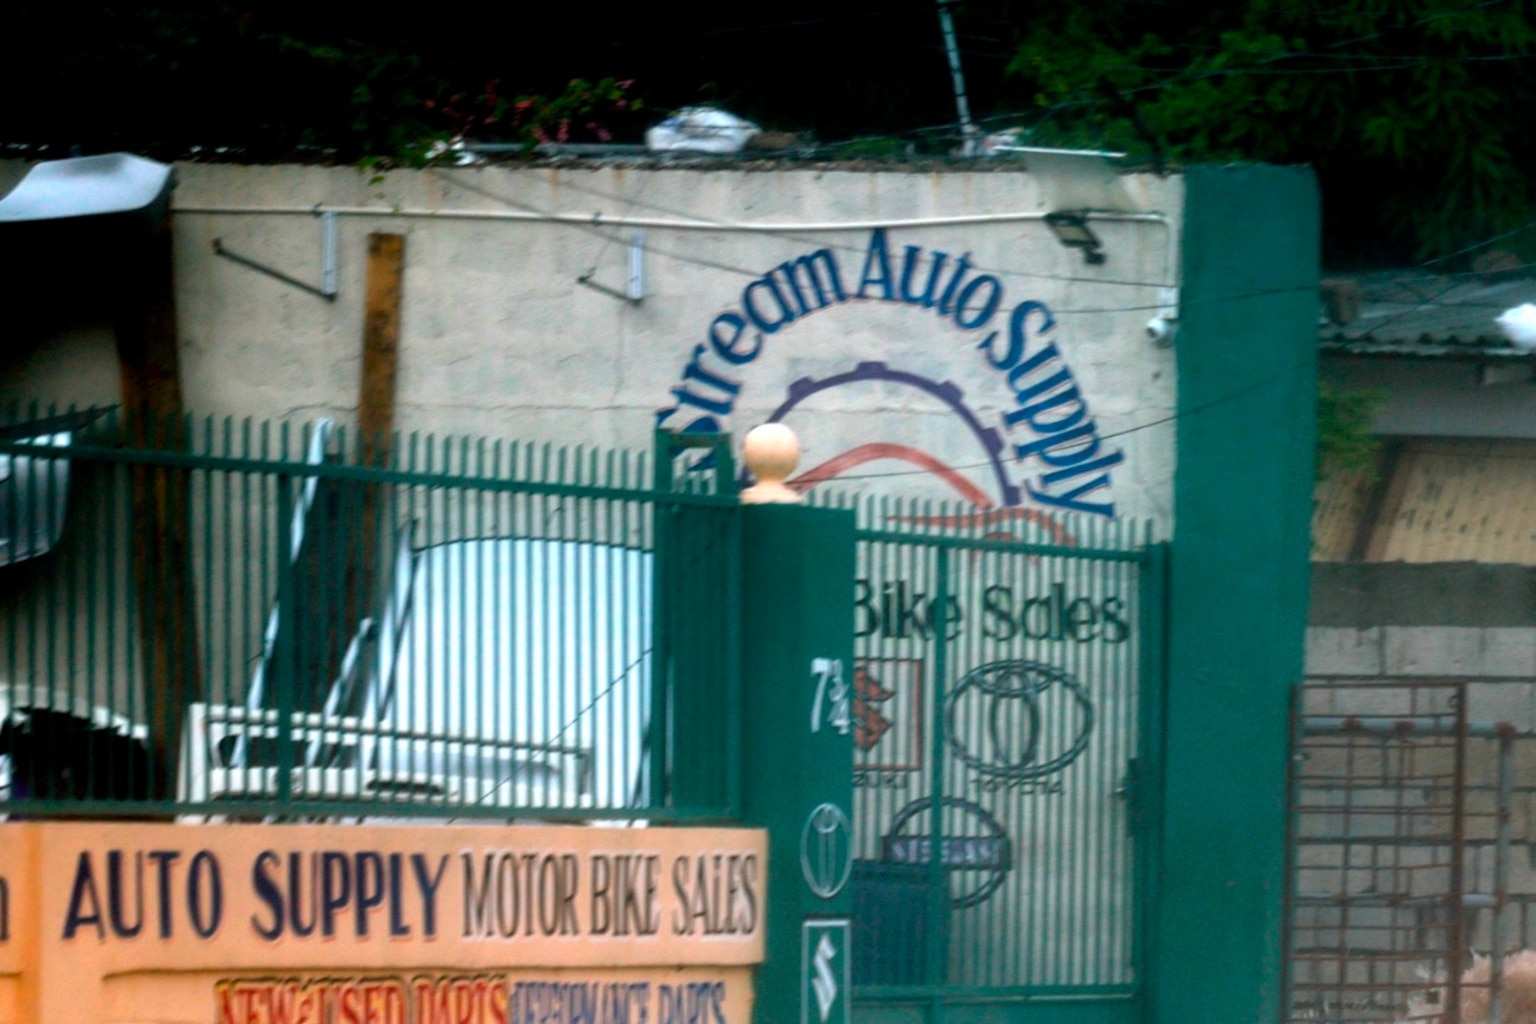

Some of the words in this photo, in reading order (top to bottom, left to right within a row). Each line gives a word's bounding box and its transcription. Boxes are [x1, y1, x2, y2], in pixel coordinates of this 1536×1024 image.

[858, 227, 1004, 331] Auto
[979, 299, 1125, 519] Supply
[982, 583, 1132, 645] Sales
[61, 849, 224, 940] AUTO
[251, 849, 451, 942] SUPPLY
[460, 848, 581, 940] MOTOR
[589, 852, 661, 938] BIKE
[672, 851, 759, 940] SALES
